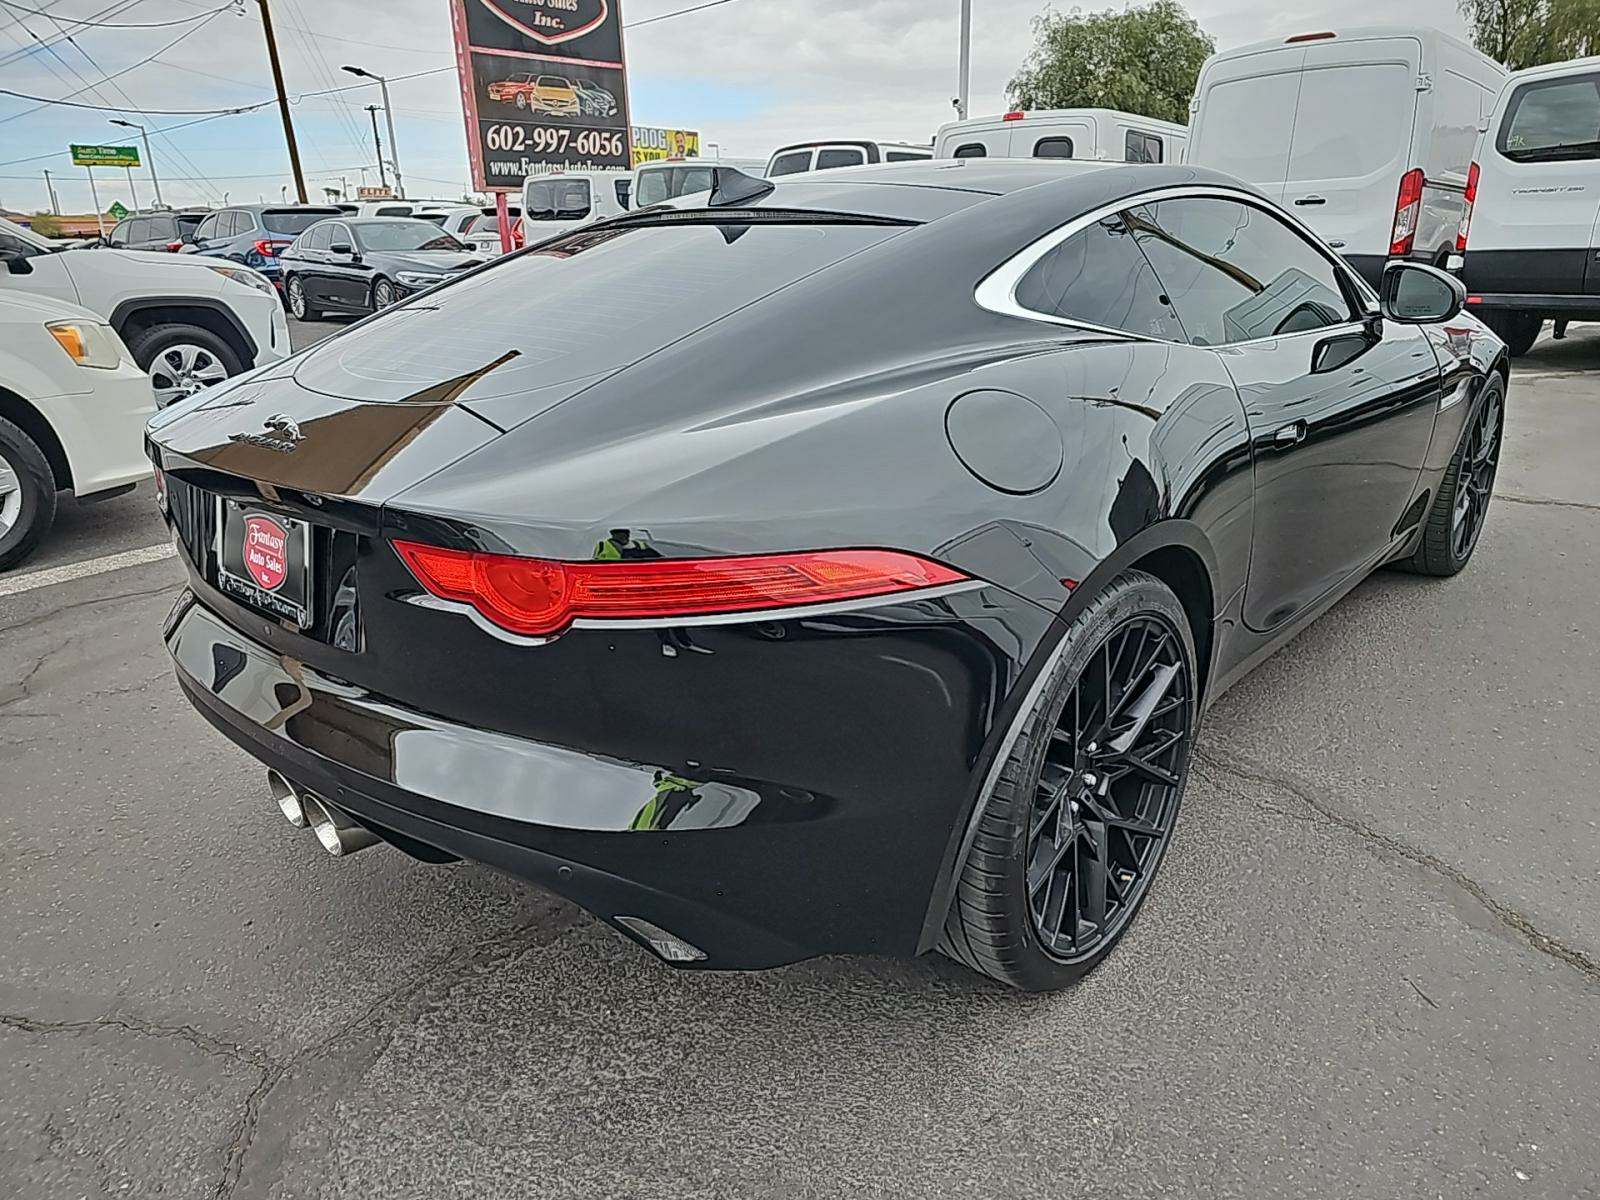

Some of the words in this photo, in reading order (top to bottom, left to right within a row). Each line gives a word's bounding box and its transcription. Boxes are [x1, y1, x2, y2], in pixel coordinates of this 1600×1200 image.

[533, 11, 565, 29] Inc.
[486, 125, 623, 156] 602-997-6056
[249, 523, 284, 559] Fantasy
[249, 549, 264, 566] Auto
[265, 554, 283, 574] Sales
